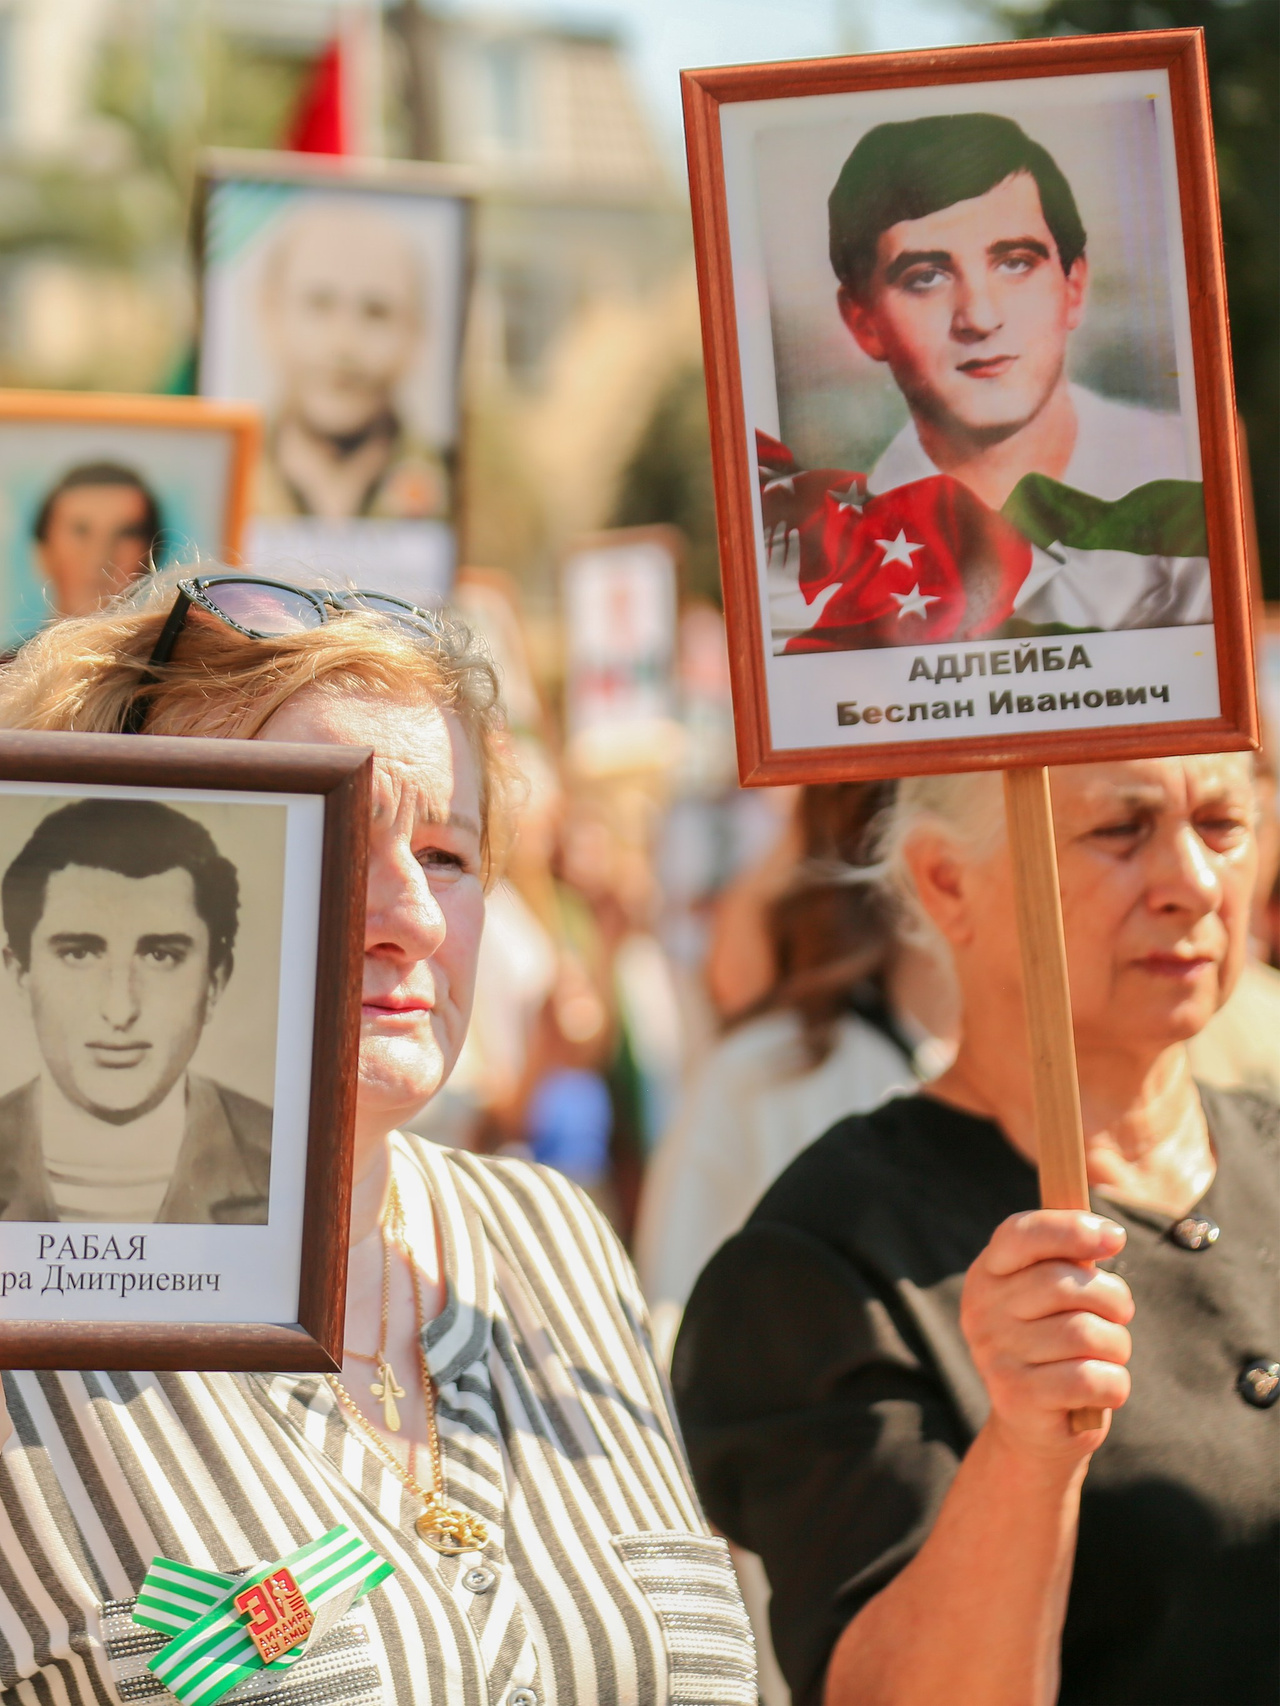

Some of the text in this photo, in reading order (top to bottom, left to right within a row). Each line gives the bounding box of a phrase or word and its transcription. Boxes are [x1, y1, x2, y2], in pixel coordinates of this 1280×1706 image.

[908, 643, 1093, 684] АДЛЕЙБА
[835, 684, 1171, 727] Беслан Иванович
[36, 1233, 148, 1261] РАБАЯ
[40, 1264, 221, 1299] Дмитриевич
